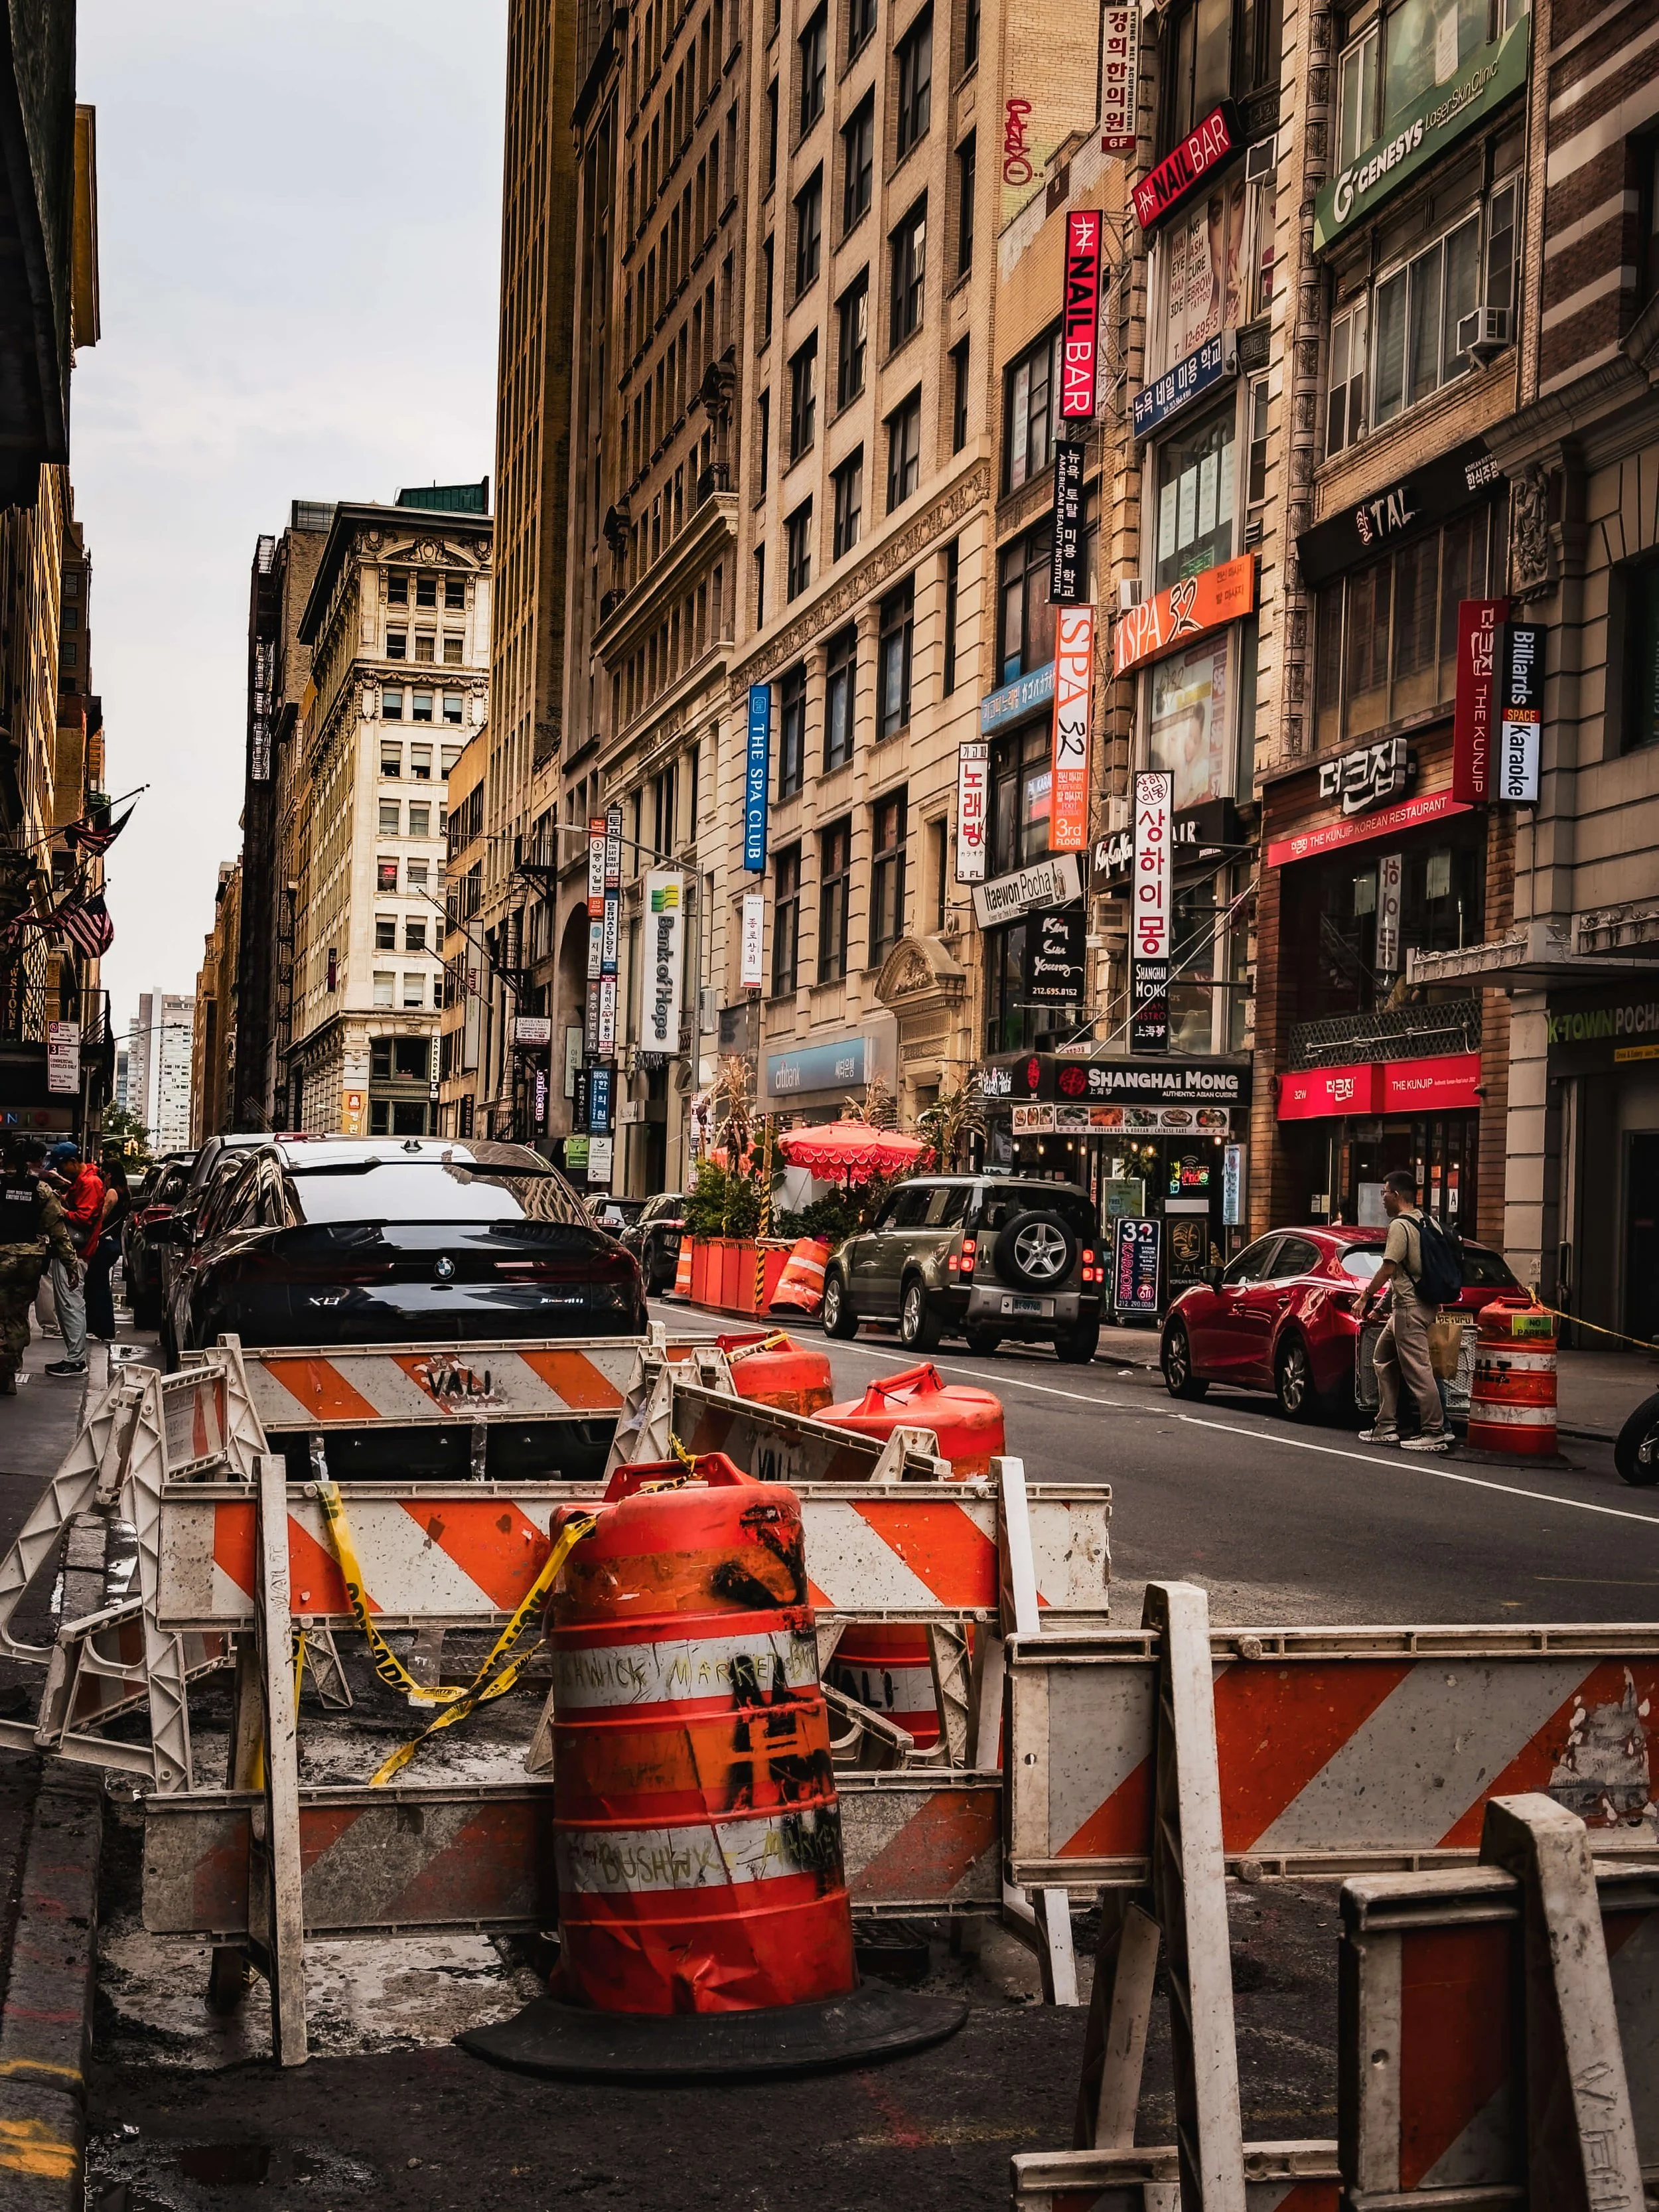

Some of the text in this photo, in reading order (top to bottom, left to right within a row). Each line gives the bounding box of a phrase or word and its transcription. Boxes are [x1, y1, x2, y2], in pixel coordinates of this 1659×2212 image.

[1104, 12, 1128, 133] 경희한의원
[1109, 137, 1127, 147] 6F
[1358, 119, 1423, 193] GENESYS
[1425, 98, 1451, 131] Laser
[1451, 82, 1471, 109] Skin
[1471, 60, 1498, 92] Clinic
[1153, 114, 1230, 208] NAIL BAR
[1064, 256, 1095, 411] NAIL BAR
[1134, 390, 1153, 423] 뉴욕
[1156, 377, 1175, 406] 네일
[1179, 357, 1197, 388] 미용
[1200, 337, 1222, 370] 학교
[1466, 459, 1500, 490] 한식주점
[1370, 488, 1416, 536] TAL
[1054, 547, 1062, 594] INSTITUTE
[1127, 576, 1204, 665] SPA 32
[1511, 630, 1535, 705] Billiards
[1057, 618, 1090, 764] SPA 32
[1471, 684, 1487, 792] THE KUNJIP
[1507, 709, 1536, 722] SPACE
[963, 745, 987, 758] 가고파
[1508, 724, 1532, 796] Karaoke
[748, 723, 765, 859] THE SPA CLUB
[1319, 739, 1398, 815] 더큰집
[963, 763, 983, 847] 노래방
[1056, 818, 1082, 837] 3rd
[1309, 796, 1448, 848] THE KUNJIP KOREAN RESTAURANT
[983, 881, 1021, 912] Itaewon
[1019, 867, 1052, 900] Pocha
[1137, 808, 1166, 954] 상하이몽
[607, 902, 615, 956] DERMATOLOGY
[651, 916, 675, 1039] Bank of Hope
[1033, 956, 1084, 978] Young
[1135, 964, 1167, 980] SHANGHAI
[1135, 1011, 1167, 1021] BISTRO
[1548, 1009, 1613, 1044] K-TOWN
[51, 1045, 56, 1054] 3
[775, 1061, 801, 1089] citibank
[1185, 1071, 1239, 1090] MONG
[1326, 1078, 1354, 1102] 더큰집
[1392, 1080, 1406, 1091] THE
[1407, 1078, 1433, 1090] KUNJIP
[597, 1080, 609, 1120] 한의원
[1451, 1193, 1457, 1206] A
[1123, 1222, 1153, 1242] 32
[1119, 1242, 1134, 1300] KARAOKE
[1173, 1264, 1200, 1274] TAL
[427, 1369, 492, 1396] VALI
